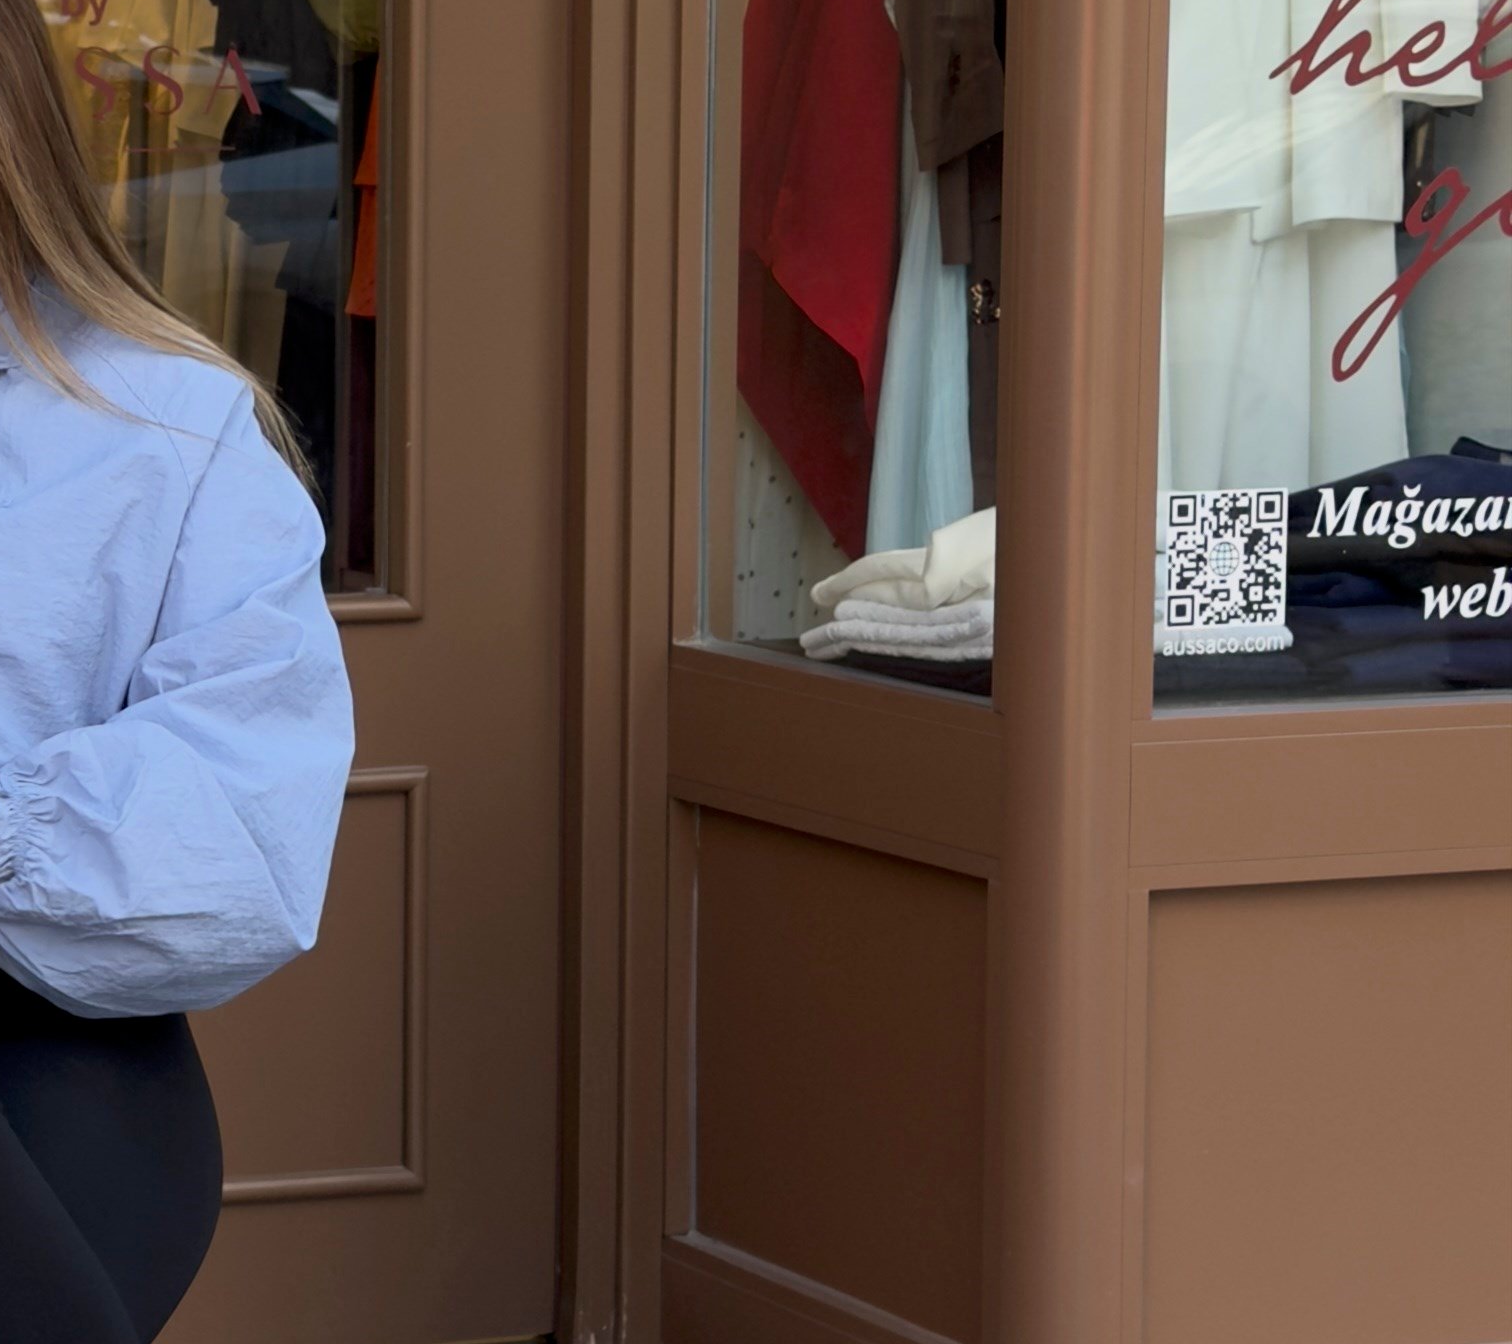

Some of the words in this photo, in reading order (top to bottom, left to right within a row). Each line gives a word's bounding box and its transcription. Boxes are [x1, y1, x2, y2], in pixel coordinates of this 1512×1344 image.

[74, 42, 264, 120] SSA
[1306, 483, 1512, 550] Mağaza
[1162, 635, 1287, 657] aussaco.com
